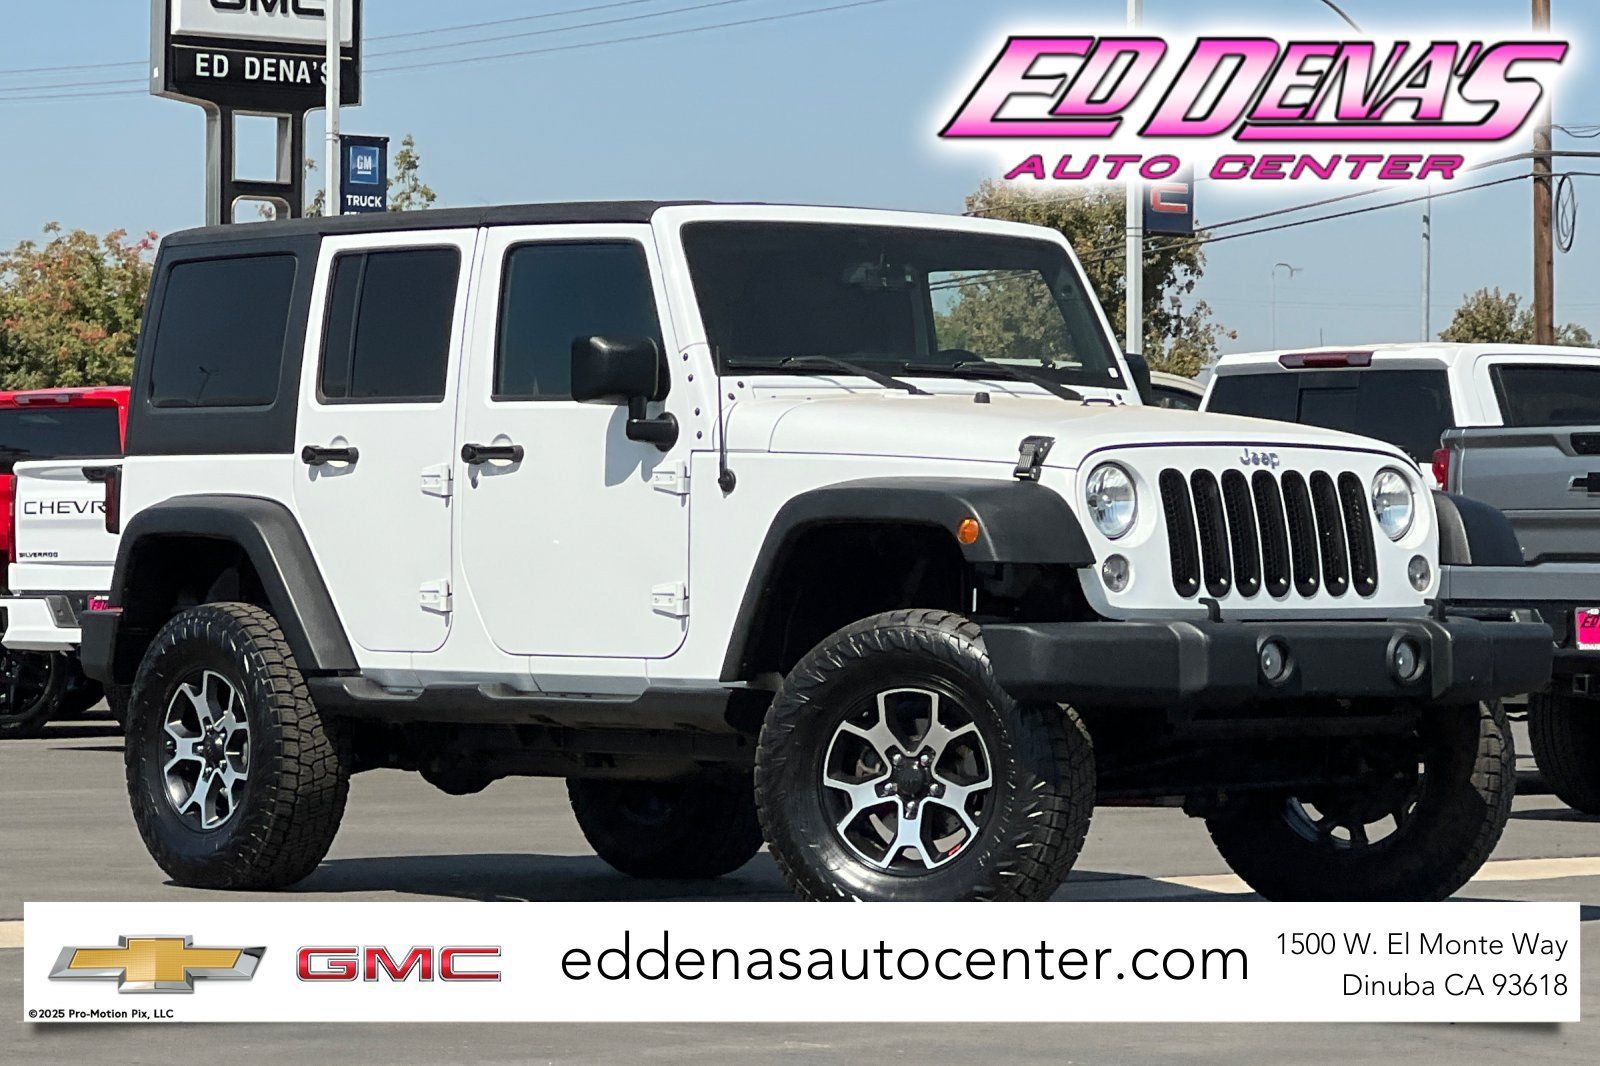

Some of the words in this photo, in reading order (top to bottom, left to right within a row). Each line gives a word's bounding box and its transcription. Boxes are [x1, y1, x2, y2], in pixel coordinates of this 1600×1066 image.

[195, 53, 229, 78] ED
[357, 155, 372, 171] GM
[346, 194, 383, 208] TRUCK
[1239, 447, 1280, 470] Jeep
